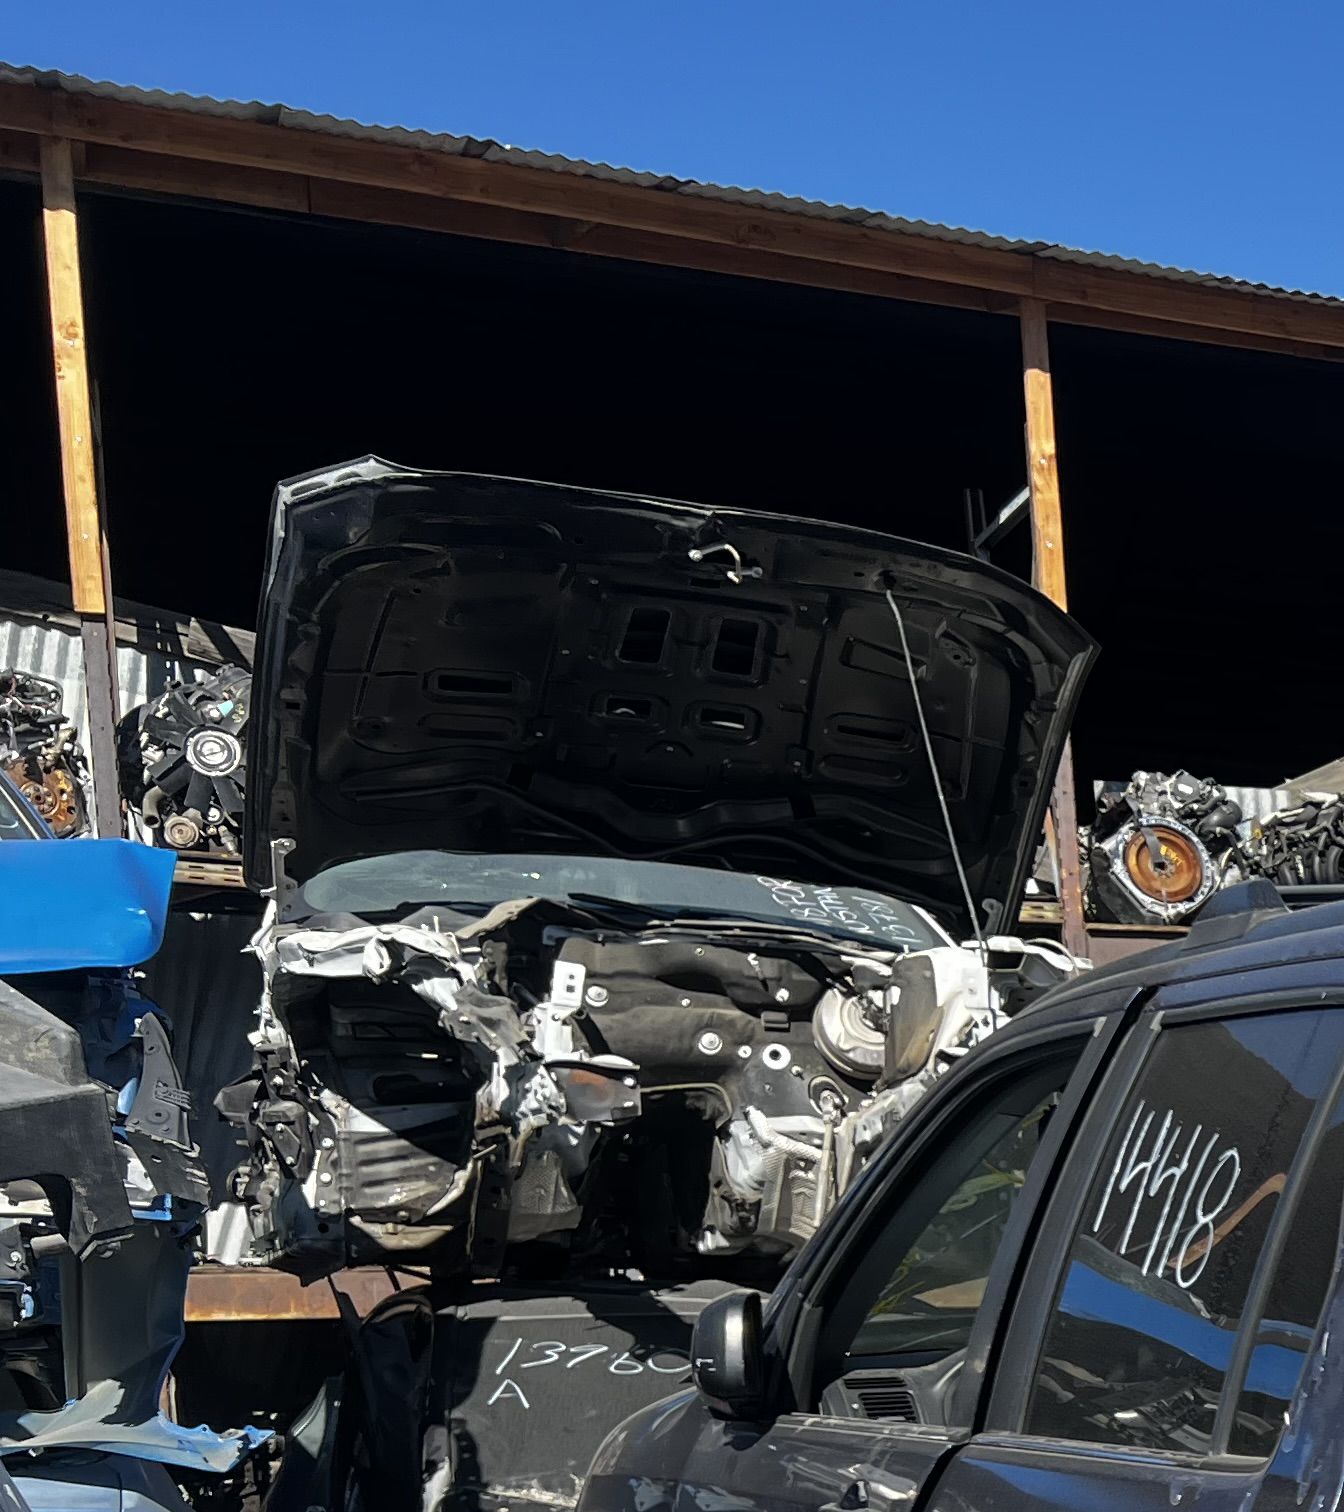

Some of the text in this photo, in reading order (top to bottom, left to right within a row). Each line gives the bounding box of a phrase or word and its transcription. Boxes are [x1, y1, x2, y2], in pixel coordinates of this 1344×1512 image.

[756, 875, 818, 907] FOR
[1092, 1100, 1242, 1289] 14418
[486, 1378, 531, 1410] A
